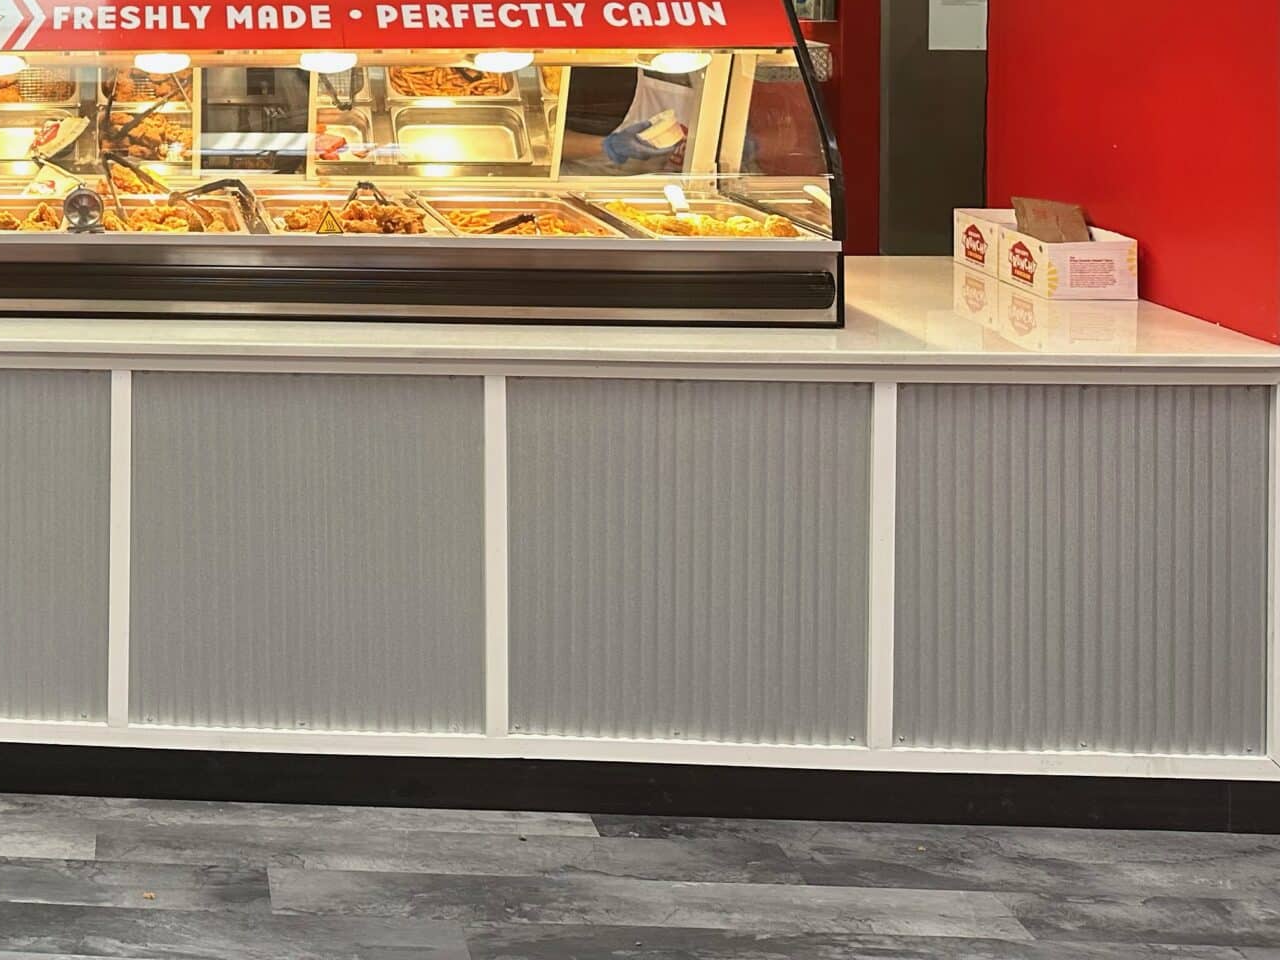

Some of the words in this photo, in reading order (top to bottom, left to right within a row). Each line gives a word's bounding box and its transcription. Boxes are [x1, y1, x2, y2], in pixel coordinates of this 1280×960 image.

[53, 5, 211, 30] FRESHLY
[227, 5, 333, 29] MADE
[378, 1, 587, 28] PERFECTLY
[603, 0, 727, 26] CAJUN
